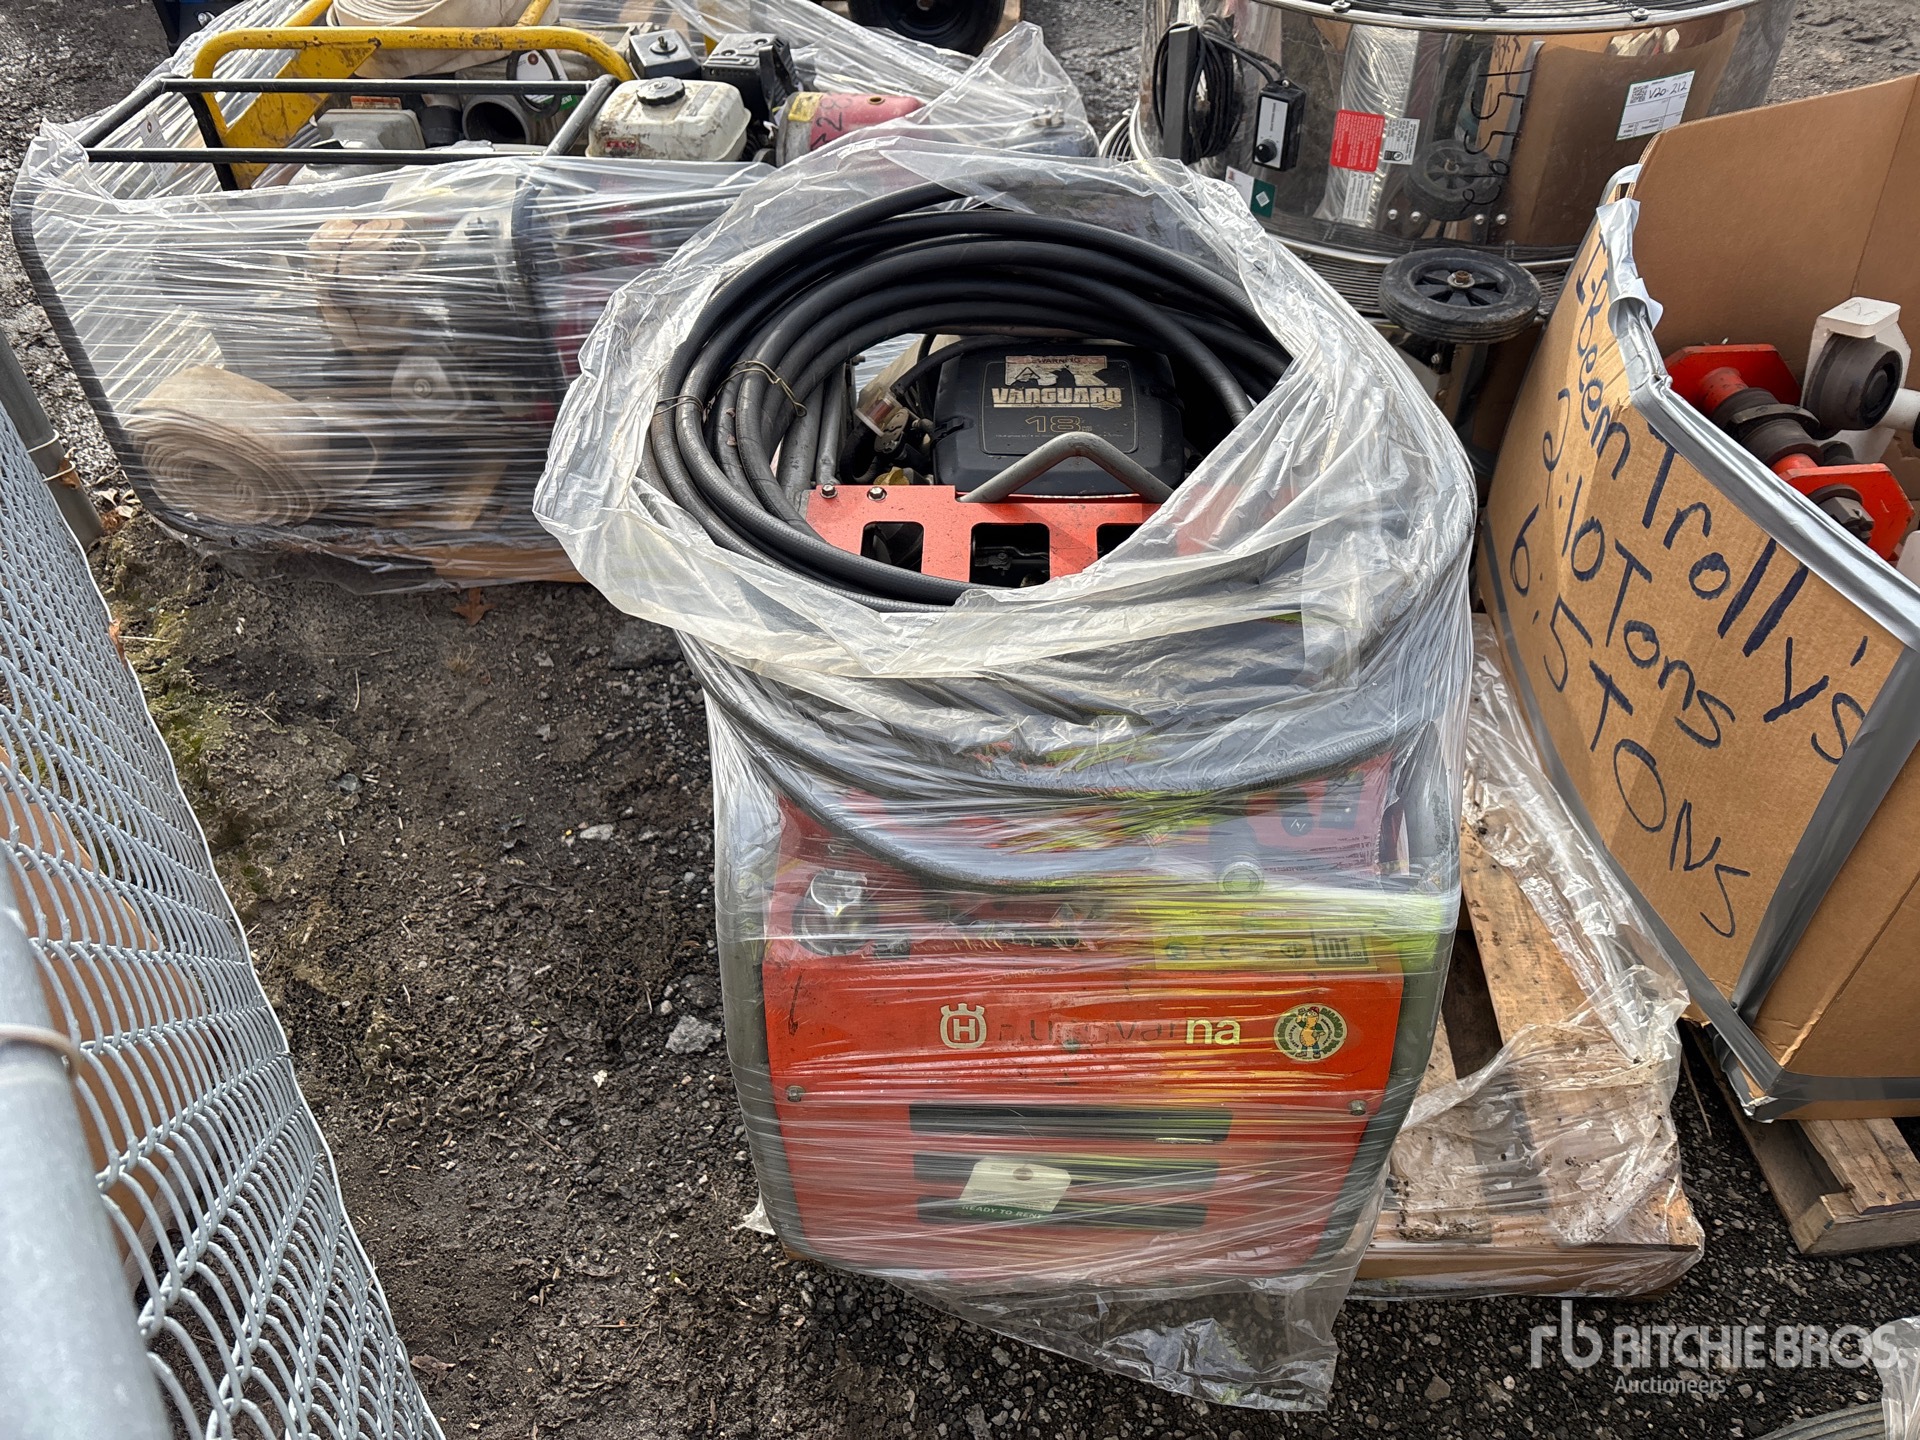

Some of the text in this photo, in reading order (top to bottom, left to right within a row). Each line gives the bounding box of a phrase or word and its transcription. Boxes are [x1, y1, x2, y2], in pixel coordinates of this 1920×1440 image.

[991, 387, 1122, 404] VANGUARD
[1025, 415, 1081, 433] 18
[1000, 1208, 1013, 1216] TO
